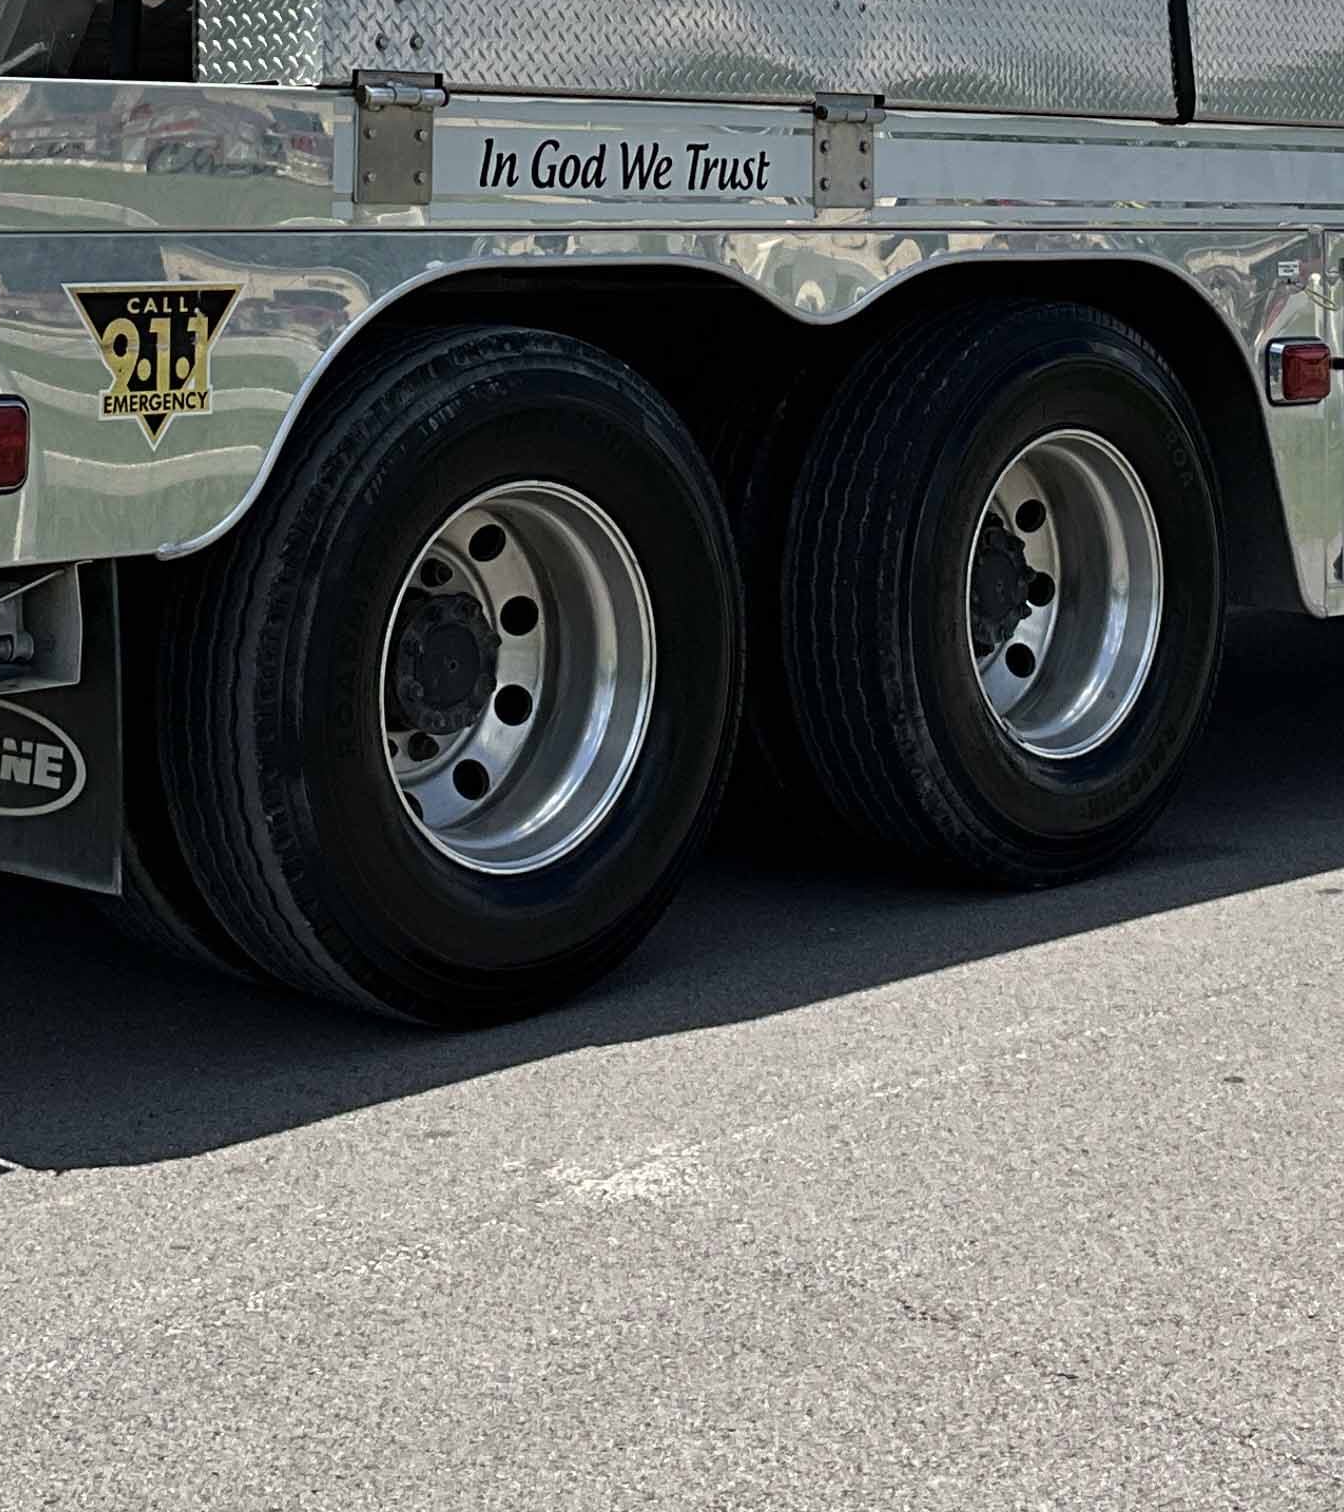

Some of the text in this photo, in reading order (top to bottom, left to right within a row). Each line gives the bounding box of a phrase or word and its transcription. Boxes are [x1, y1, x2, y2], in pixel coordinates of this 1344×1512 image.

[478, 137, 770, 191] In God We Trust
[127, 296, 188, 314] CALL
[103, 393, 208, 414] EMERGENCY
